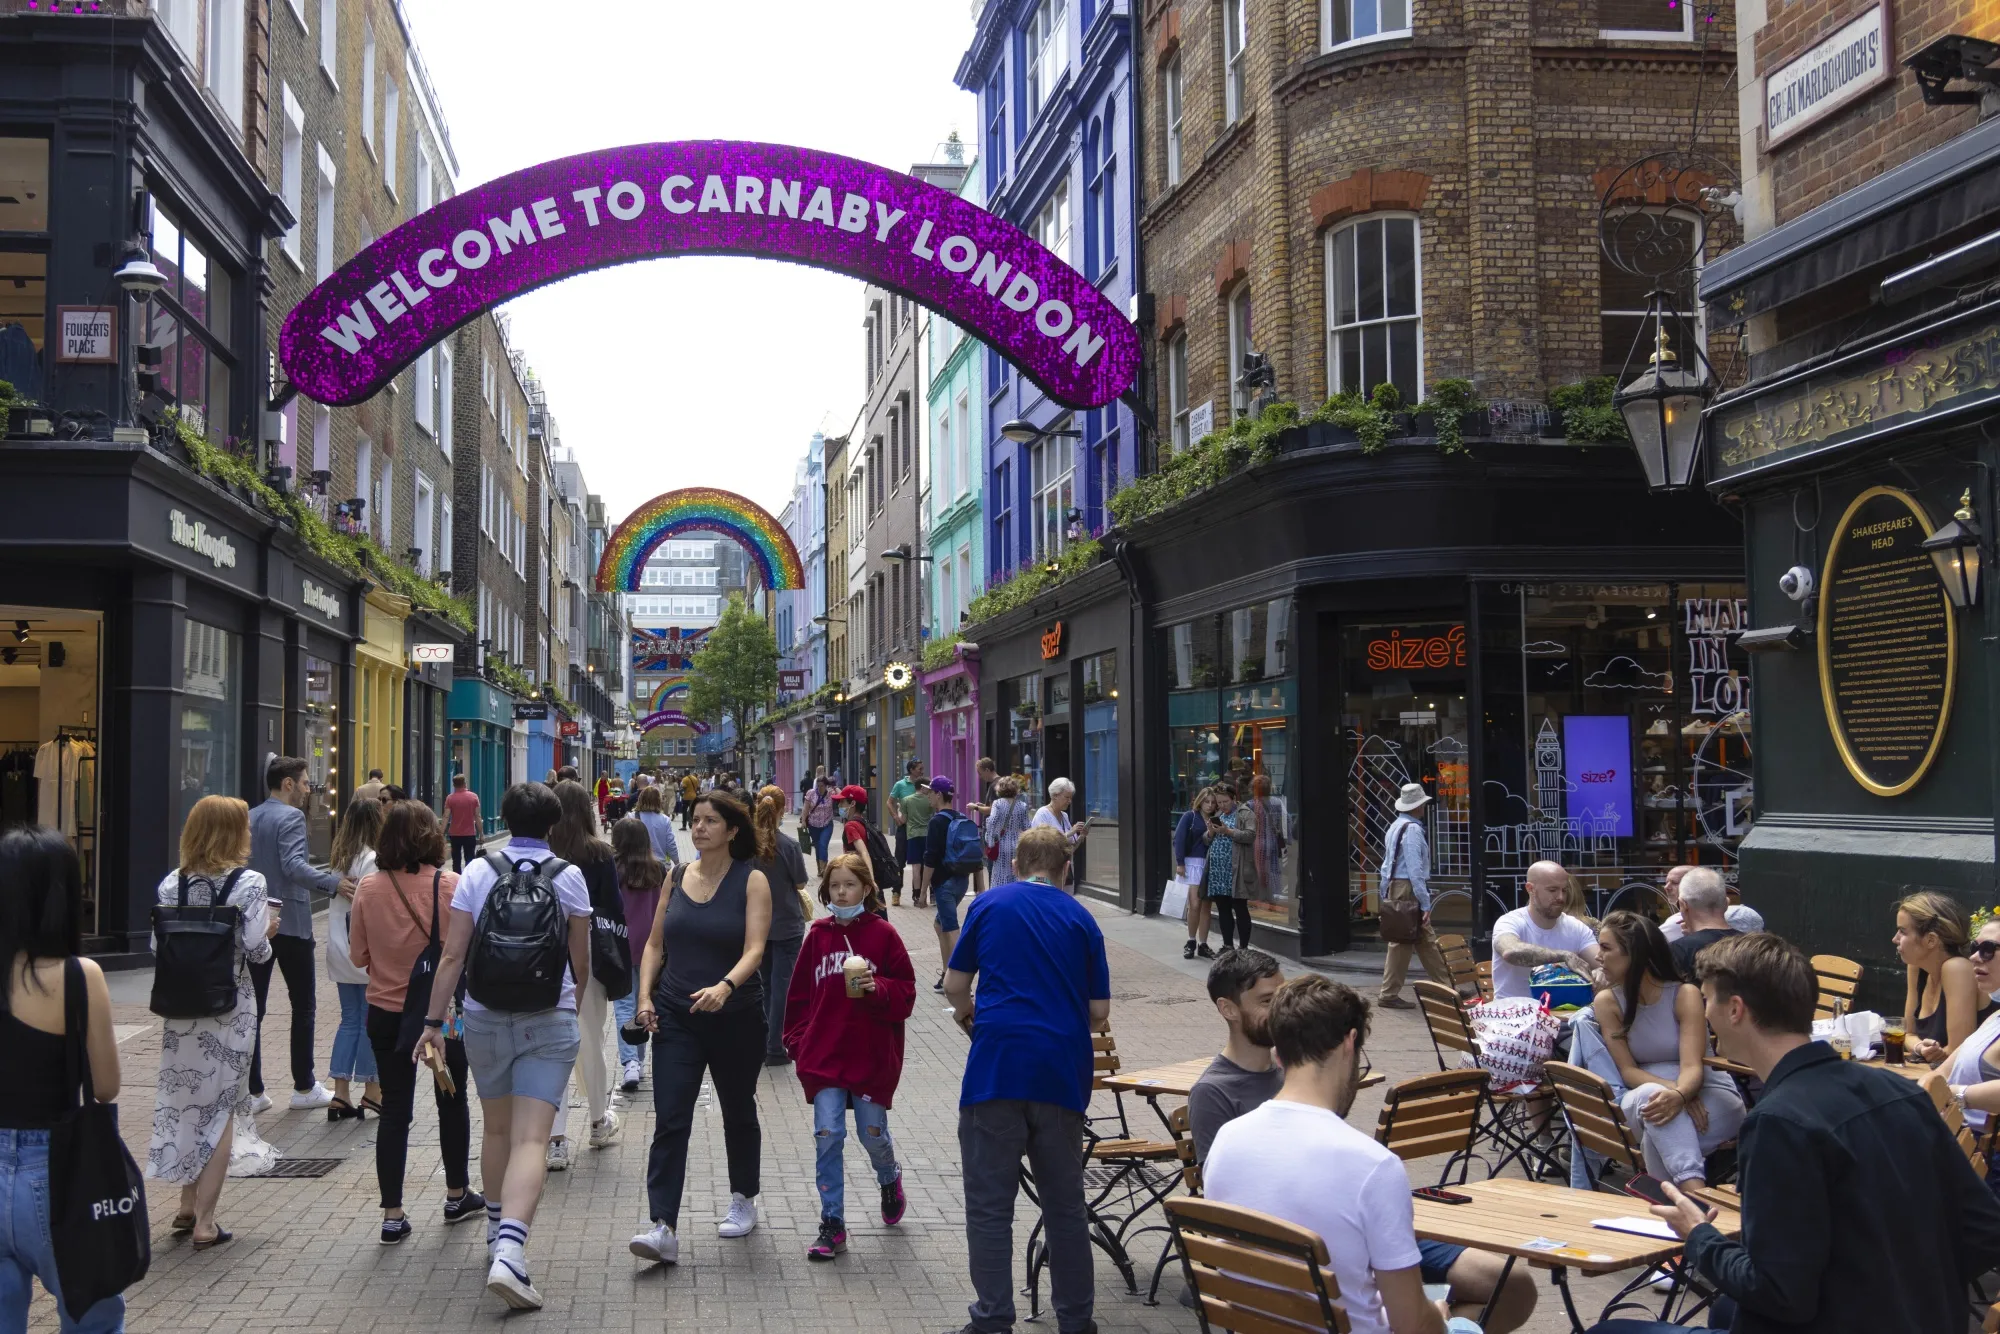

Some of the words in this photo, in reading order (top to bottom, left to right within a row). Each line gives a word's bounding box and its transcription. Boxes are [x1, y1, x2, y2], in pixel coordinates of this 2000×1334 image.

[1769, 81, 1797, 130] GREAT
[1797, 36, 1868, 113] MARLBOROUGH
[320, 197, 566, 355] WELCOME
[572, 181, 645, 228] TO
[660, 175, 907, 243] CARNABY
[911, 219, 1105, 368] LONDON
[68, 339, 96, 354] PLACE
[170, 508, 195, 548] The
[194, 521, 236, 568] Kooples
[1852, 516, 1913, 539] SHAKESPEARE'S
[1871, 536, 1894, 550] HEAD
[1041, 620, 1062, 660] size?
[1688, 637, 1729, 673] IN
[783, 675, 800, 683] MUJI
[1581, 769, 1616, 783] size?
